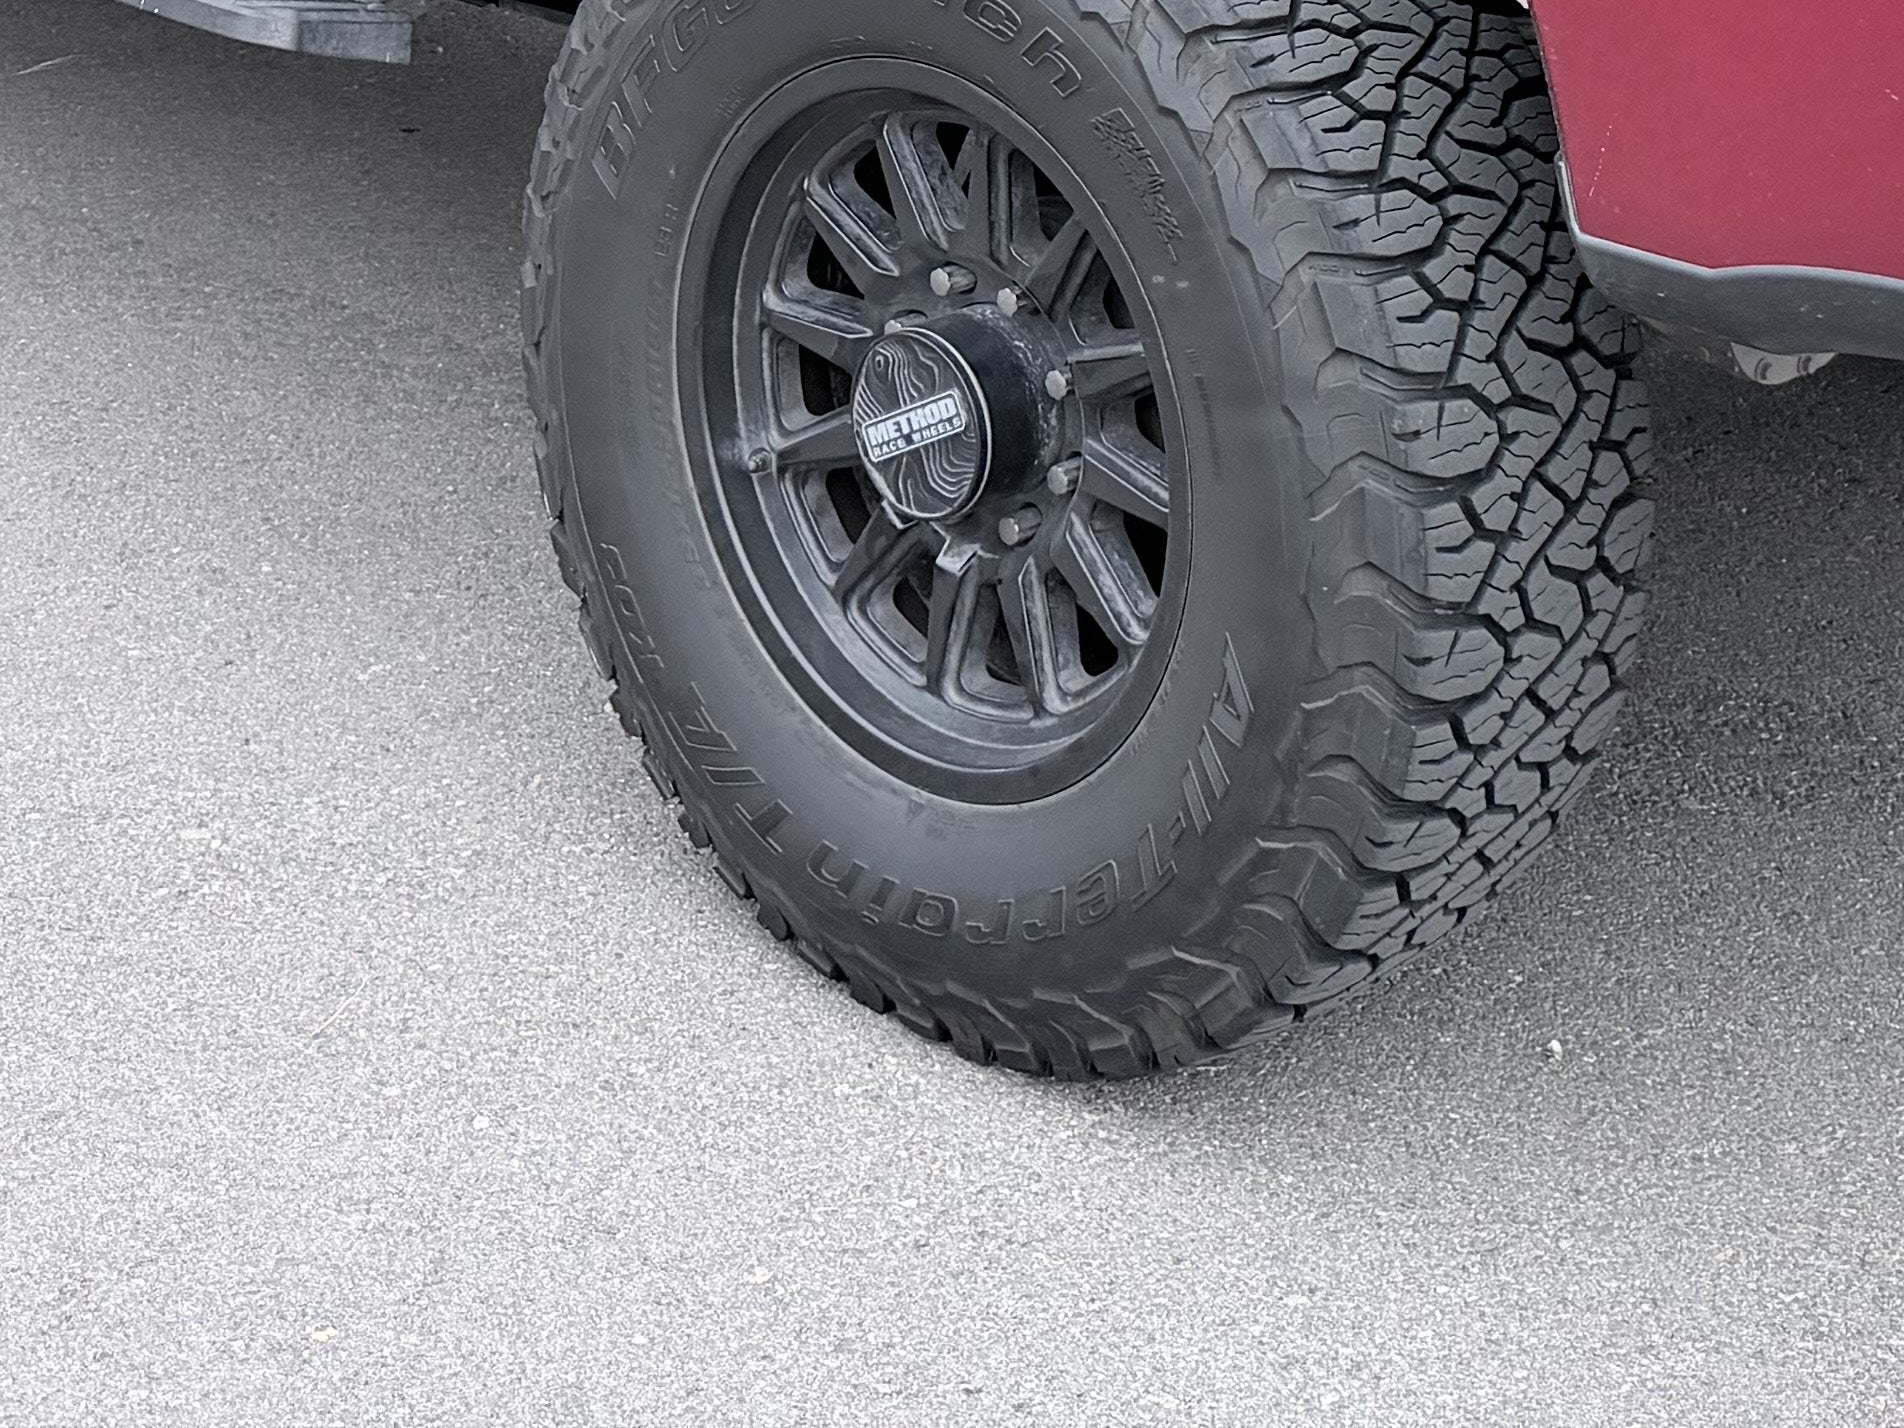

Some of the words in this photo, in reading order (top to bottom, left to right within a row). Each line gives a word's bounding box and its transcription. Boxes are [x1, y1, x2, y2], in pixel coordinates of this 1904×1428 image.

[866, 397, 957, 446] METHOD
[873, 437, 906, 458] RACE
[911, 417, 962, 442] WHEELS
